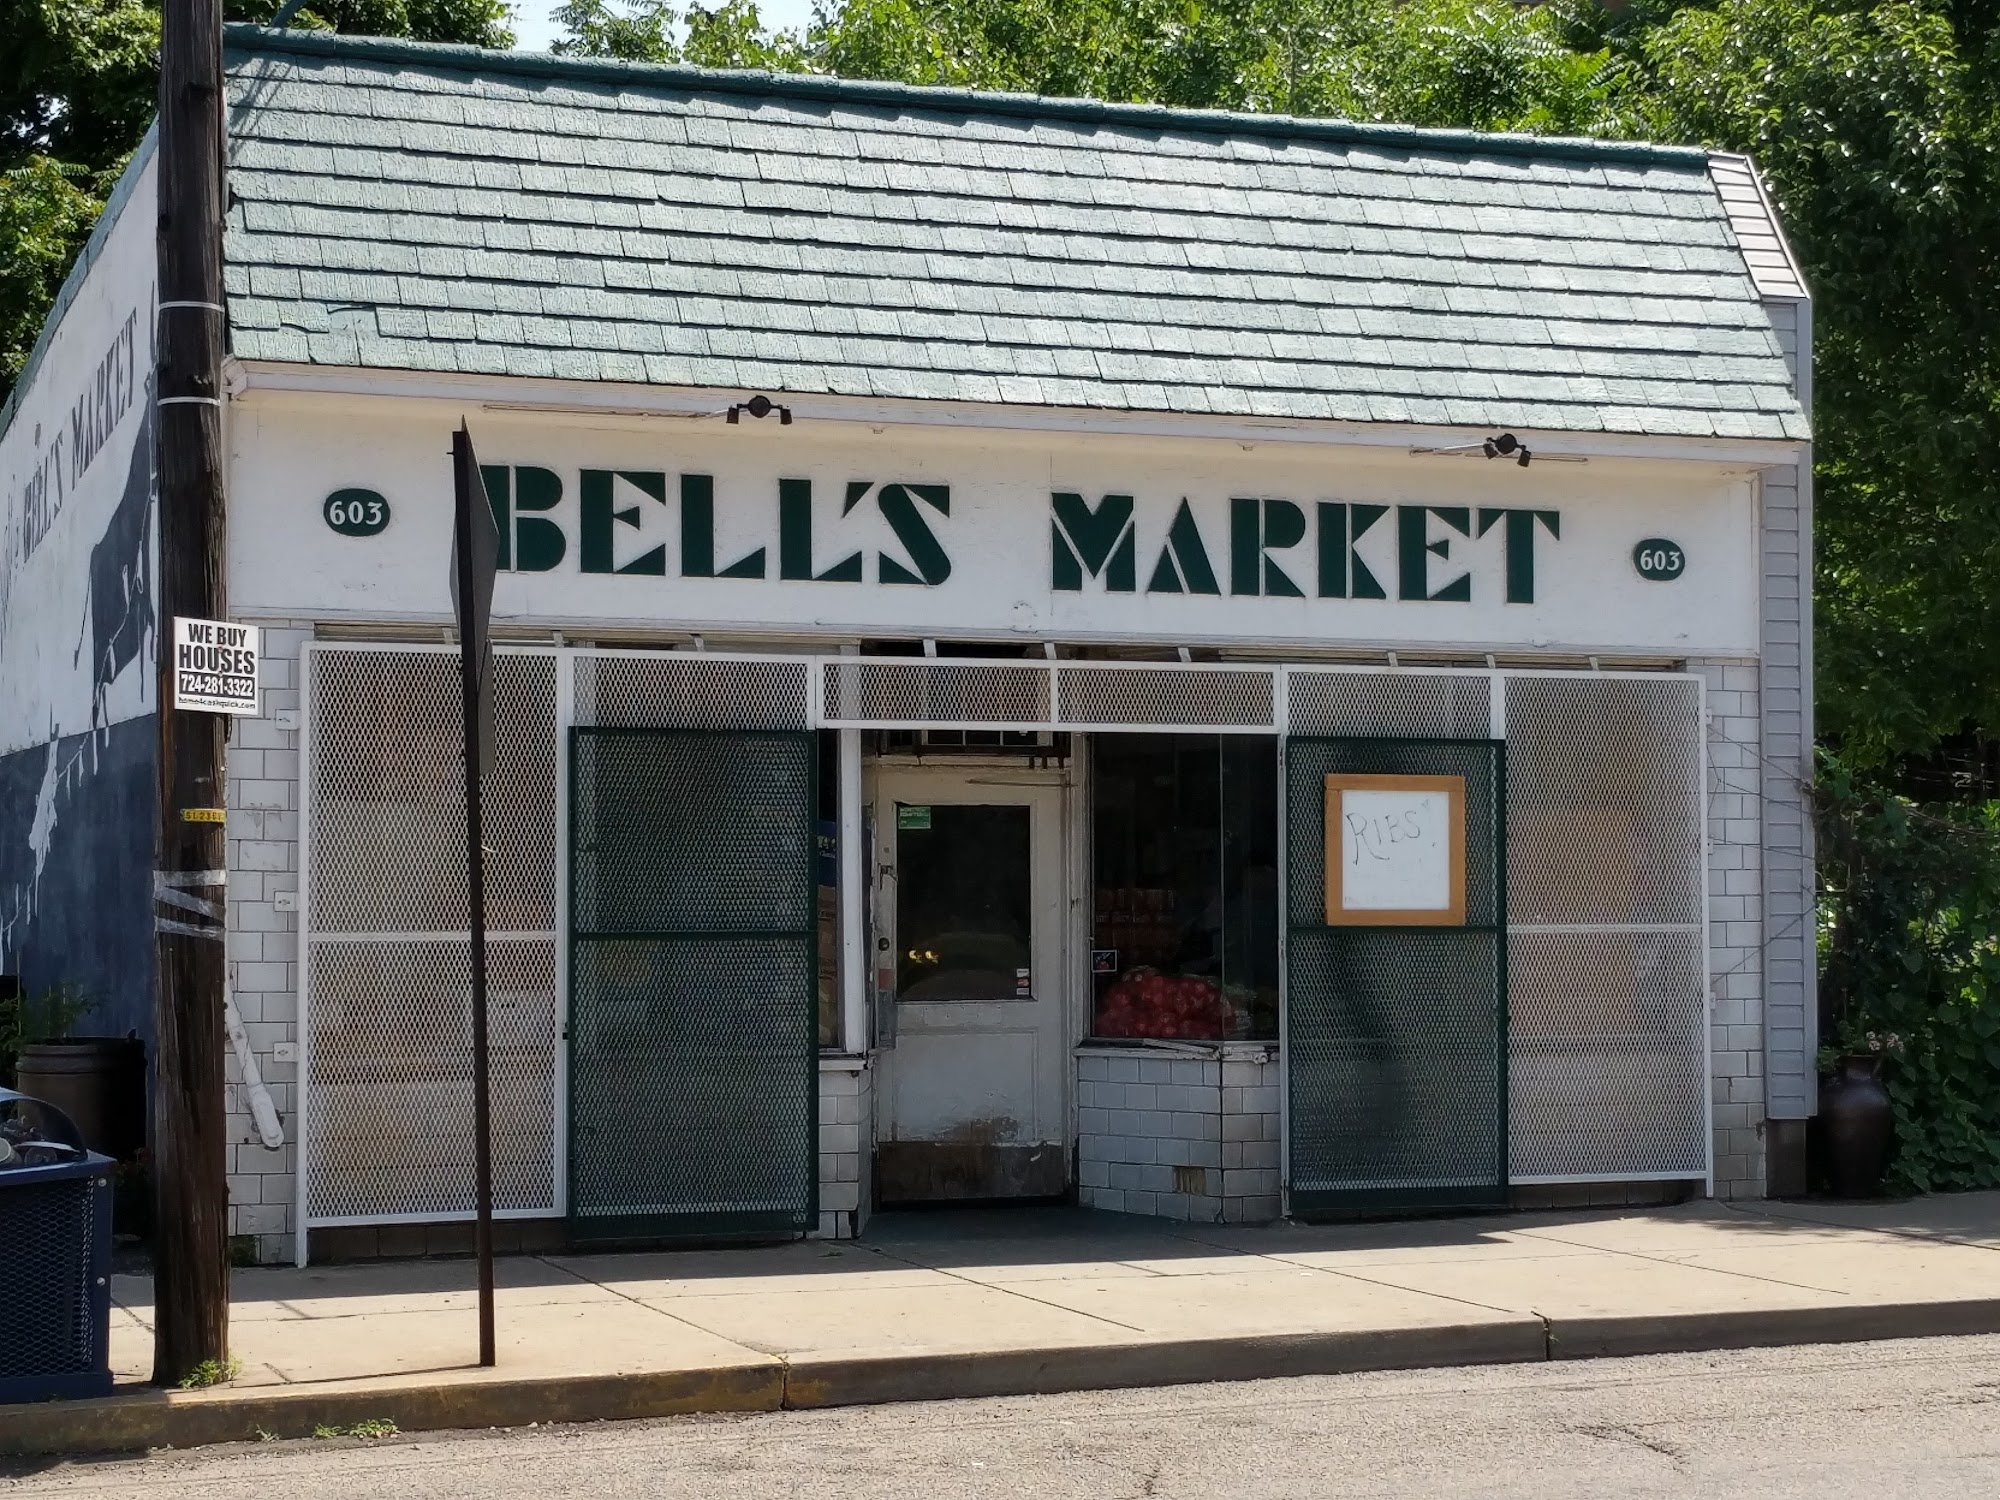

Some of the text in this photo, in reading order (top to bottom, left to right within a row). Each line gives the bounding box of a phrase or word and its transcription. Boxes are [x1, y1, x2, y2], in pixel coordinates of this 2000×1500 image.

[72, 307, 137, 492] MARKET
[329, 500, 383, 526] 603
[480, 464, 1561, 604] BELL'S MARKET
[1639, 547, 1681, 572] 603
[188, 623, 247, 647] WE BUY
[179, 644, 255, 675] HOUSES
[181, 674, 253, 697] 724-281-3322
[1345, 810, 1421, 866] RIBS
